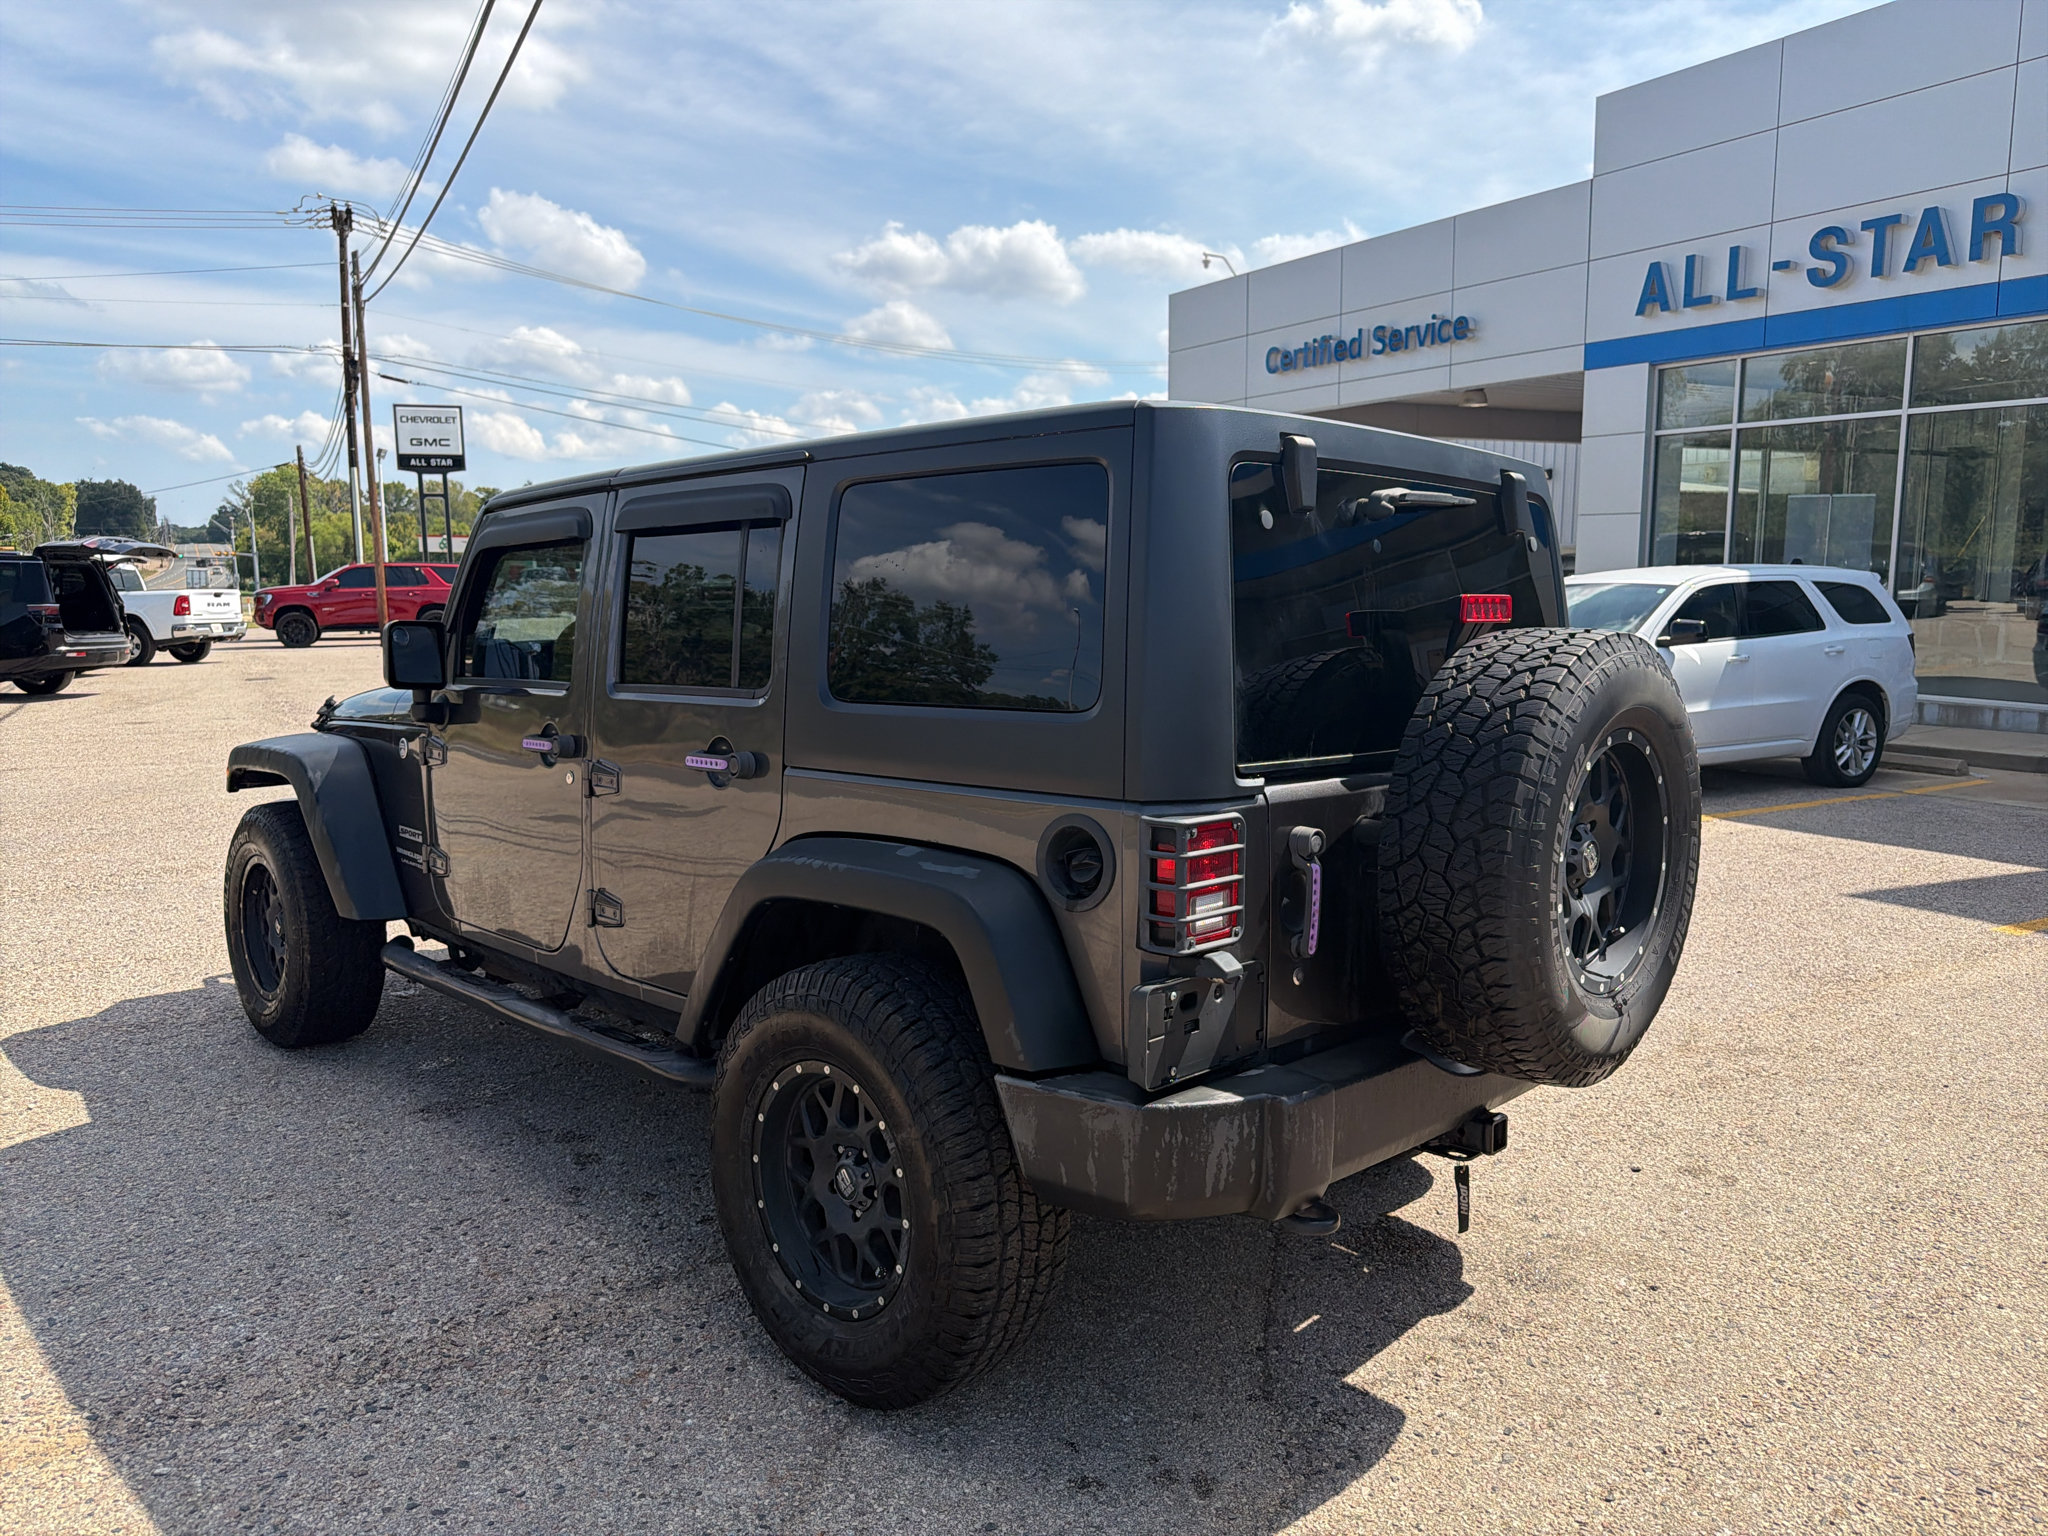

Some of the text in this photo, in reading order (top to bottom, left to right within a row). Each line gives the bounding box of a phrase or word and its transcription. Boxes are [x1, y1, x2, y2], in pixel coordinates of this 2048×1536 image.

[1635, 192, 2027, 317] ALL-STAR
[1265, 313, 1474, 375] Certified Service
[399, 415, 457, 424] CHEVROLET
[410, 437, 451, 447] GMC
[410, 458, 453, 467] ALL STAR
[400, 827, 422, 840] SPORT
